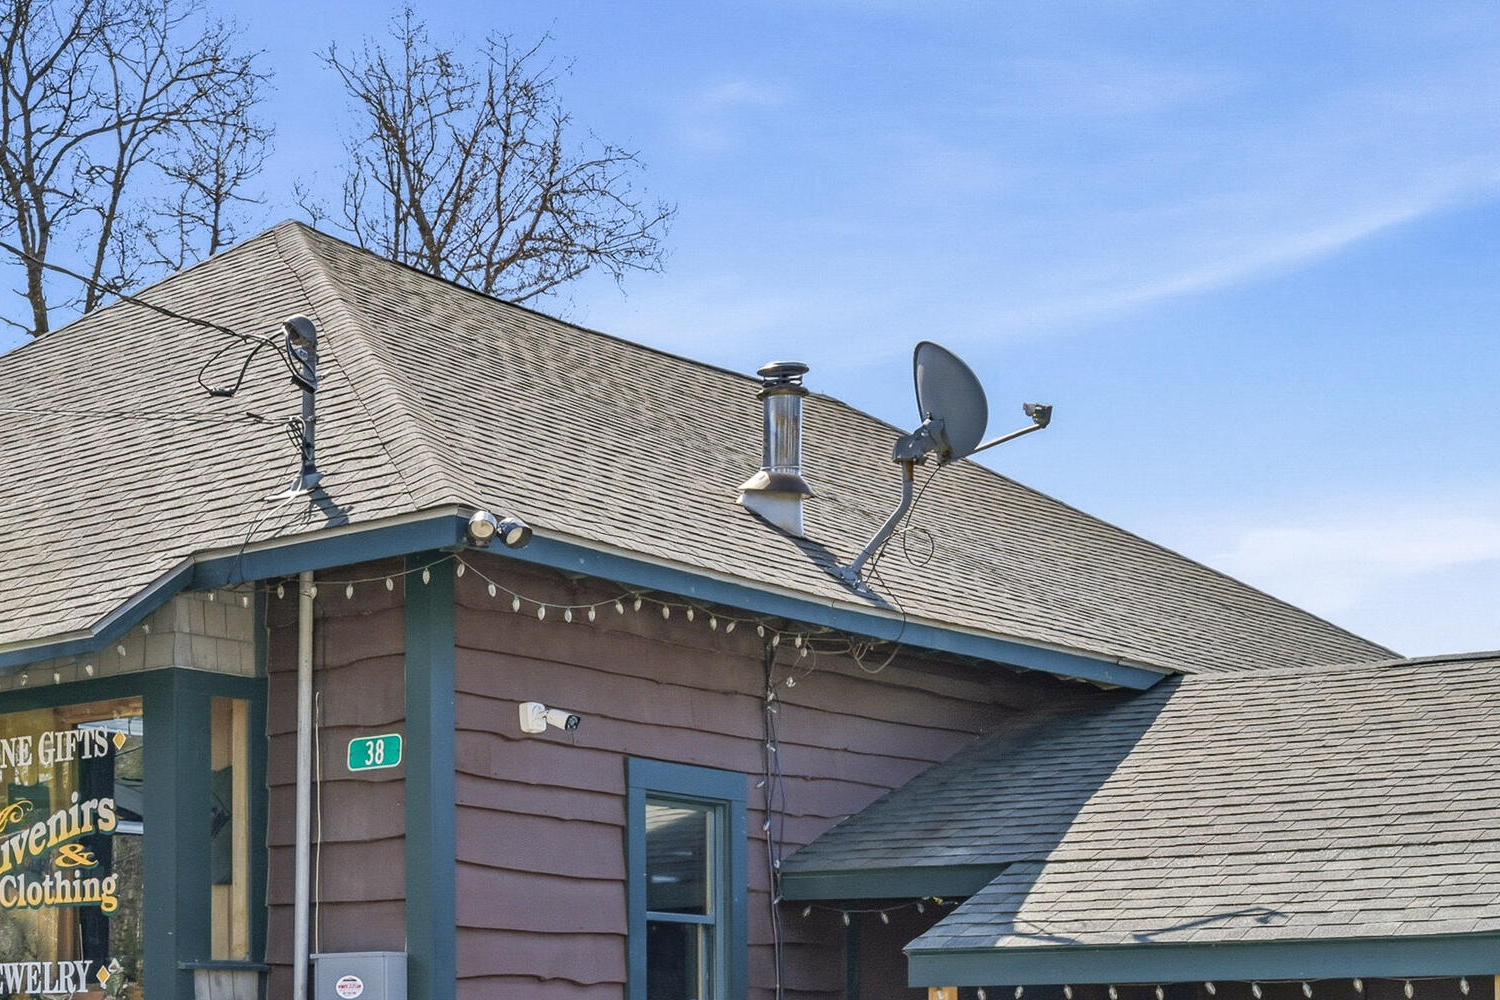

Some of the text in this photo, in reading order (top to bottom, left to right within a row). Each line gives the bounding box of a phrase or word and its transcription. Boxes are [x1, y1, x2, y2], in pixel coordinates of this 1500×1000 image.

[38, 727, 109, 766] GIFTS
[365, 739, 384, 765] 38
[55, 843, 98, 868] &
[0, 870, 119, 912] Clothing
